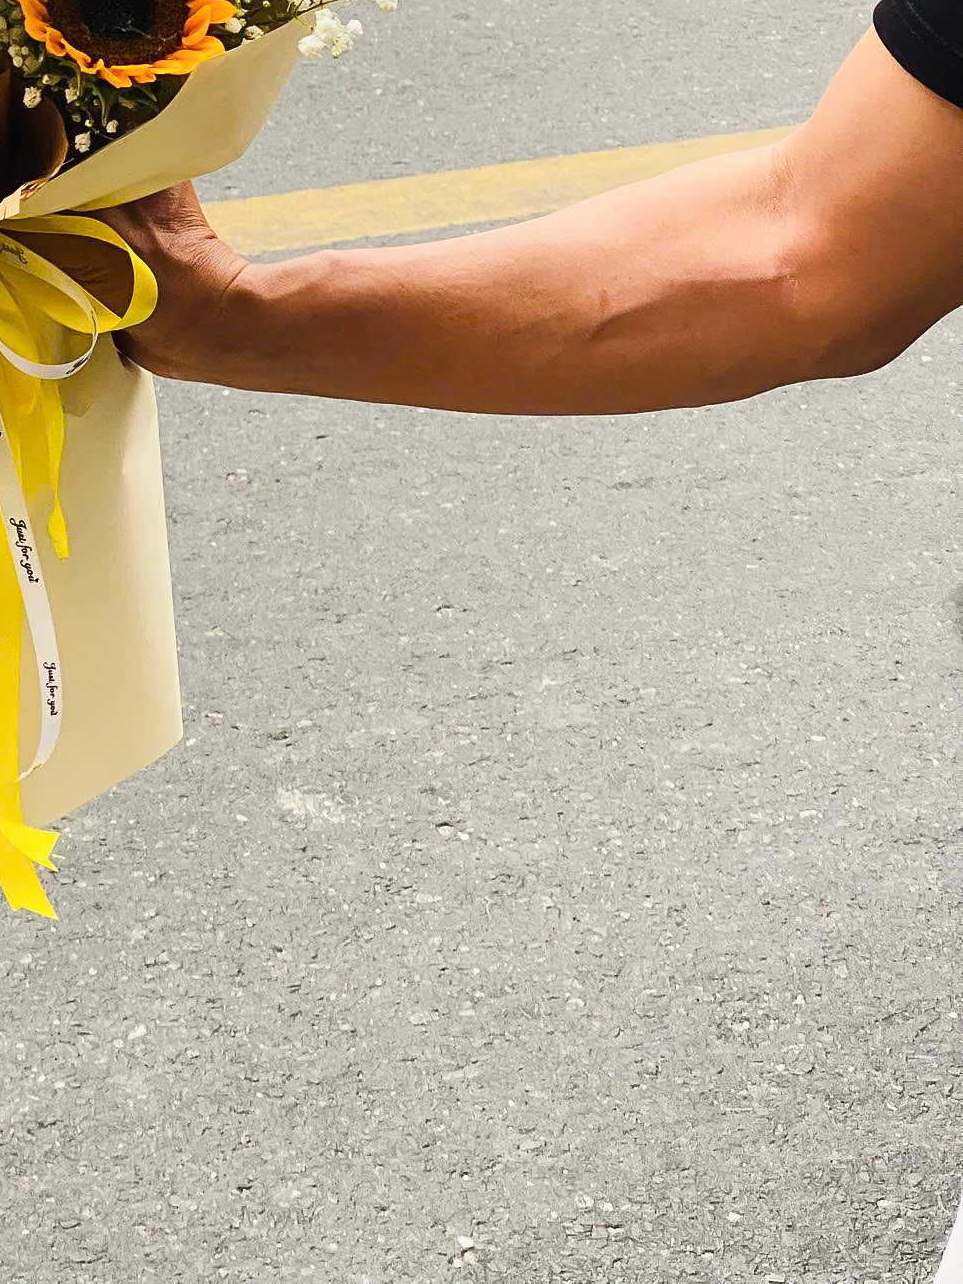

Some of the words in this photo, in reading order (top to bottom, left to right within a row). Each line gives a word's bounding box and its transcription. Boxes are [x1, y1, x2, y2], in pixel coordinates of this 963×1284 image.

[9, 517, 28, 543] Just
[15, 540, 32, 561] for
[20, 559, 39, 583] you
[43, 661, 56, 683] Just
[46, 682, 58, 698] for
[47, 698, 58, 716] you
